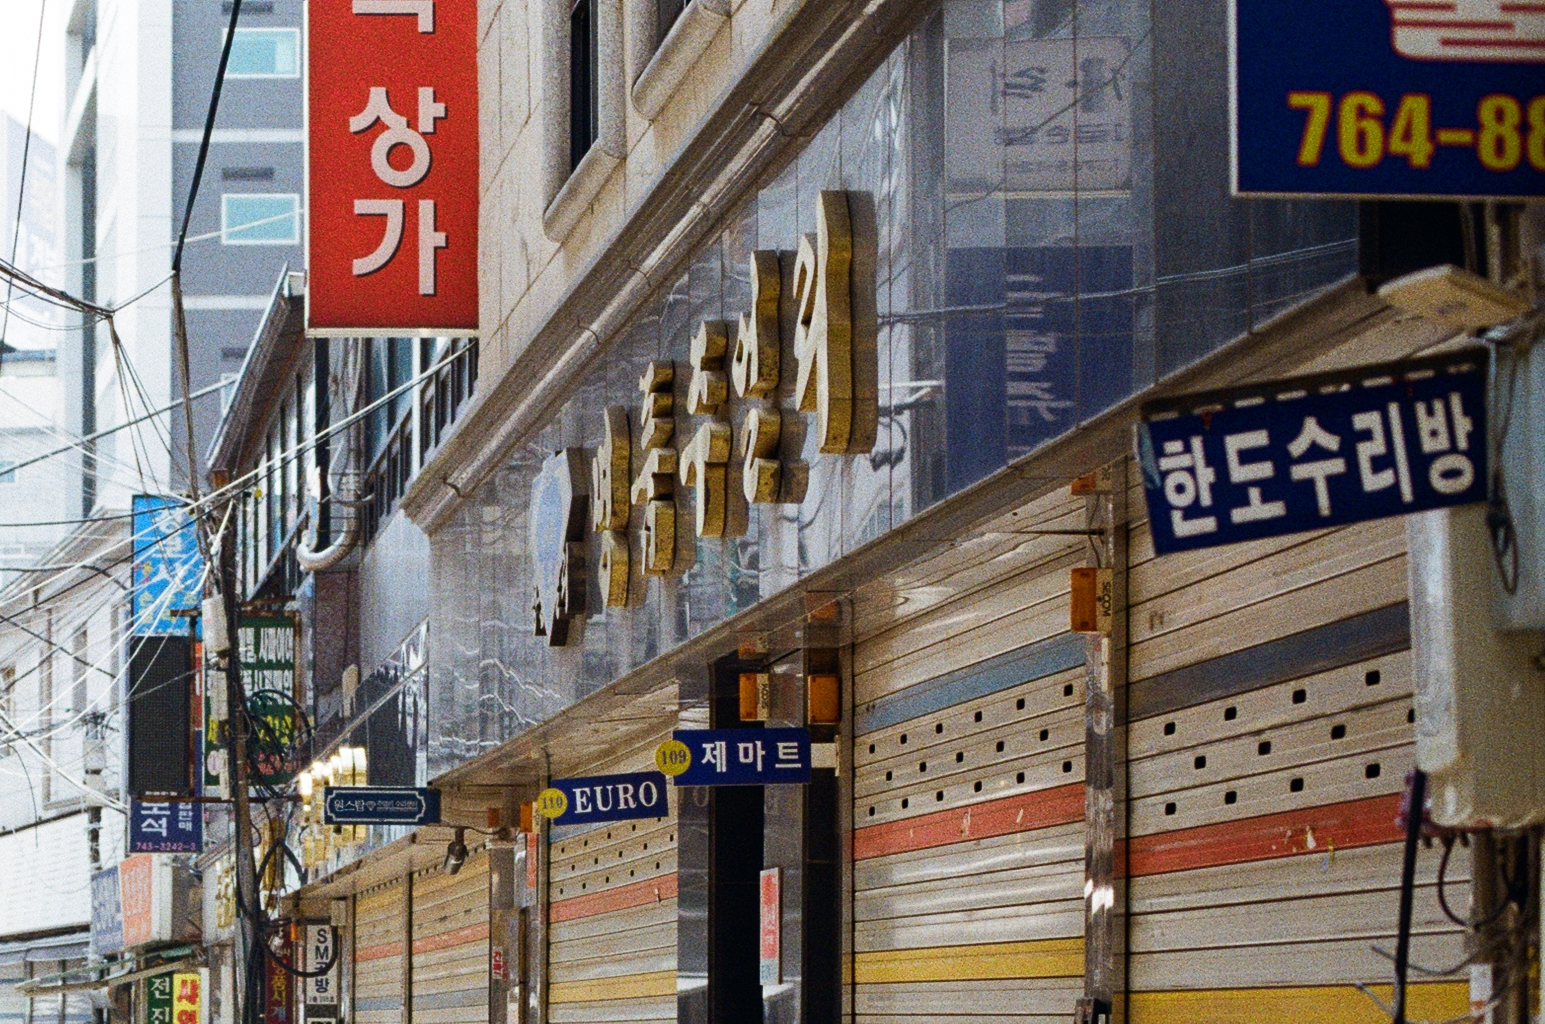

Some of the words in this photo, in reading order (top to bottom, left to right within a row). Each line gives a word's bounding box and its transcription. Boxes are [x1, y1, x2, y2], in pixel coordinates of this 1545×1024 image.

[1159, 391, 1476, 539] 한도수리방
[661, 749, 688, 766] 109
[701, 740, 802, 773] 제마트
[542, 795, 564, 809] 110
[572, 780, 658, 815] EURO
